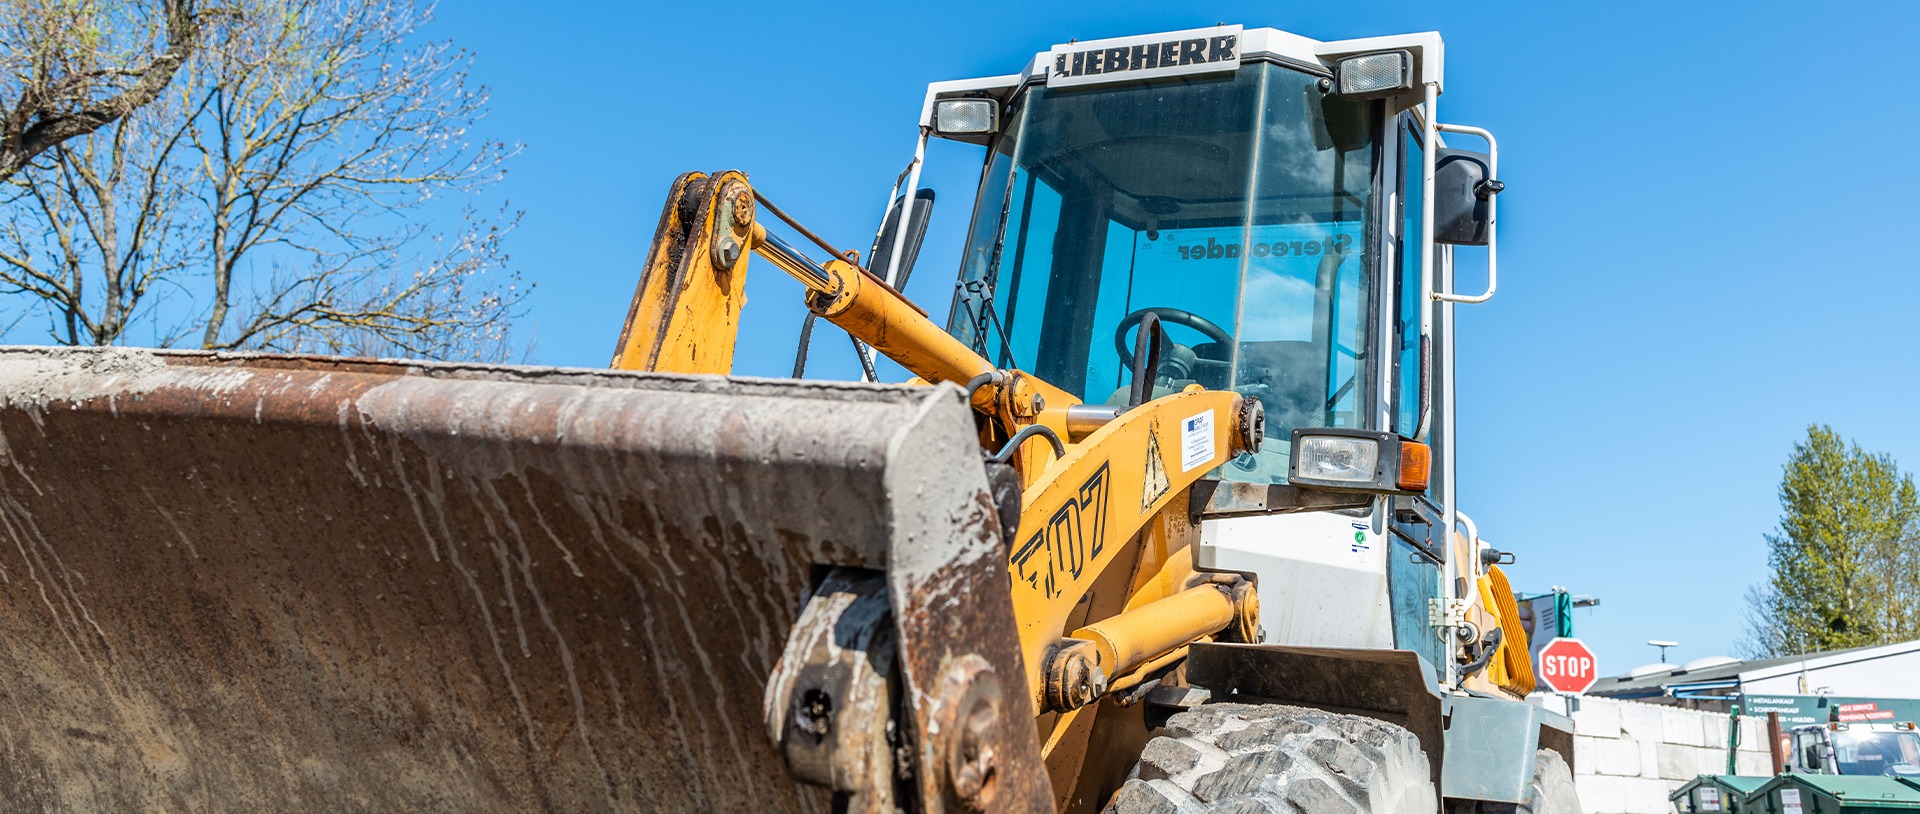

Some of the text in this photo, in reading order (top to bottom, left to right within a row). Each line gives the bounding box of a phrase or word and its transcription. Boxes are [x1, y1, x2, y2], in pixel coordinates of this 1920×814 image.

[1053, 34, 1237, 78] LIEBHERR
[1546, 655, 1591, 678] STOP
[1754, 706, 1800, 714] SCHROTTANKAUF
